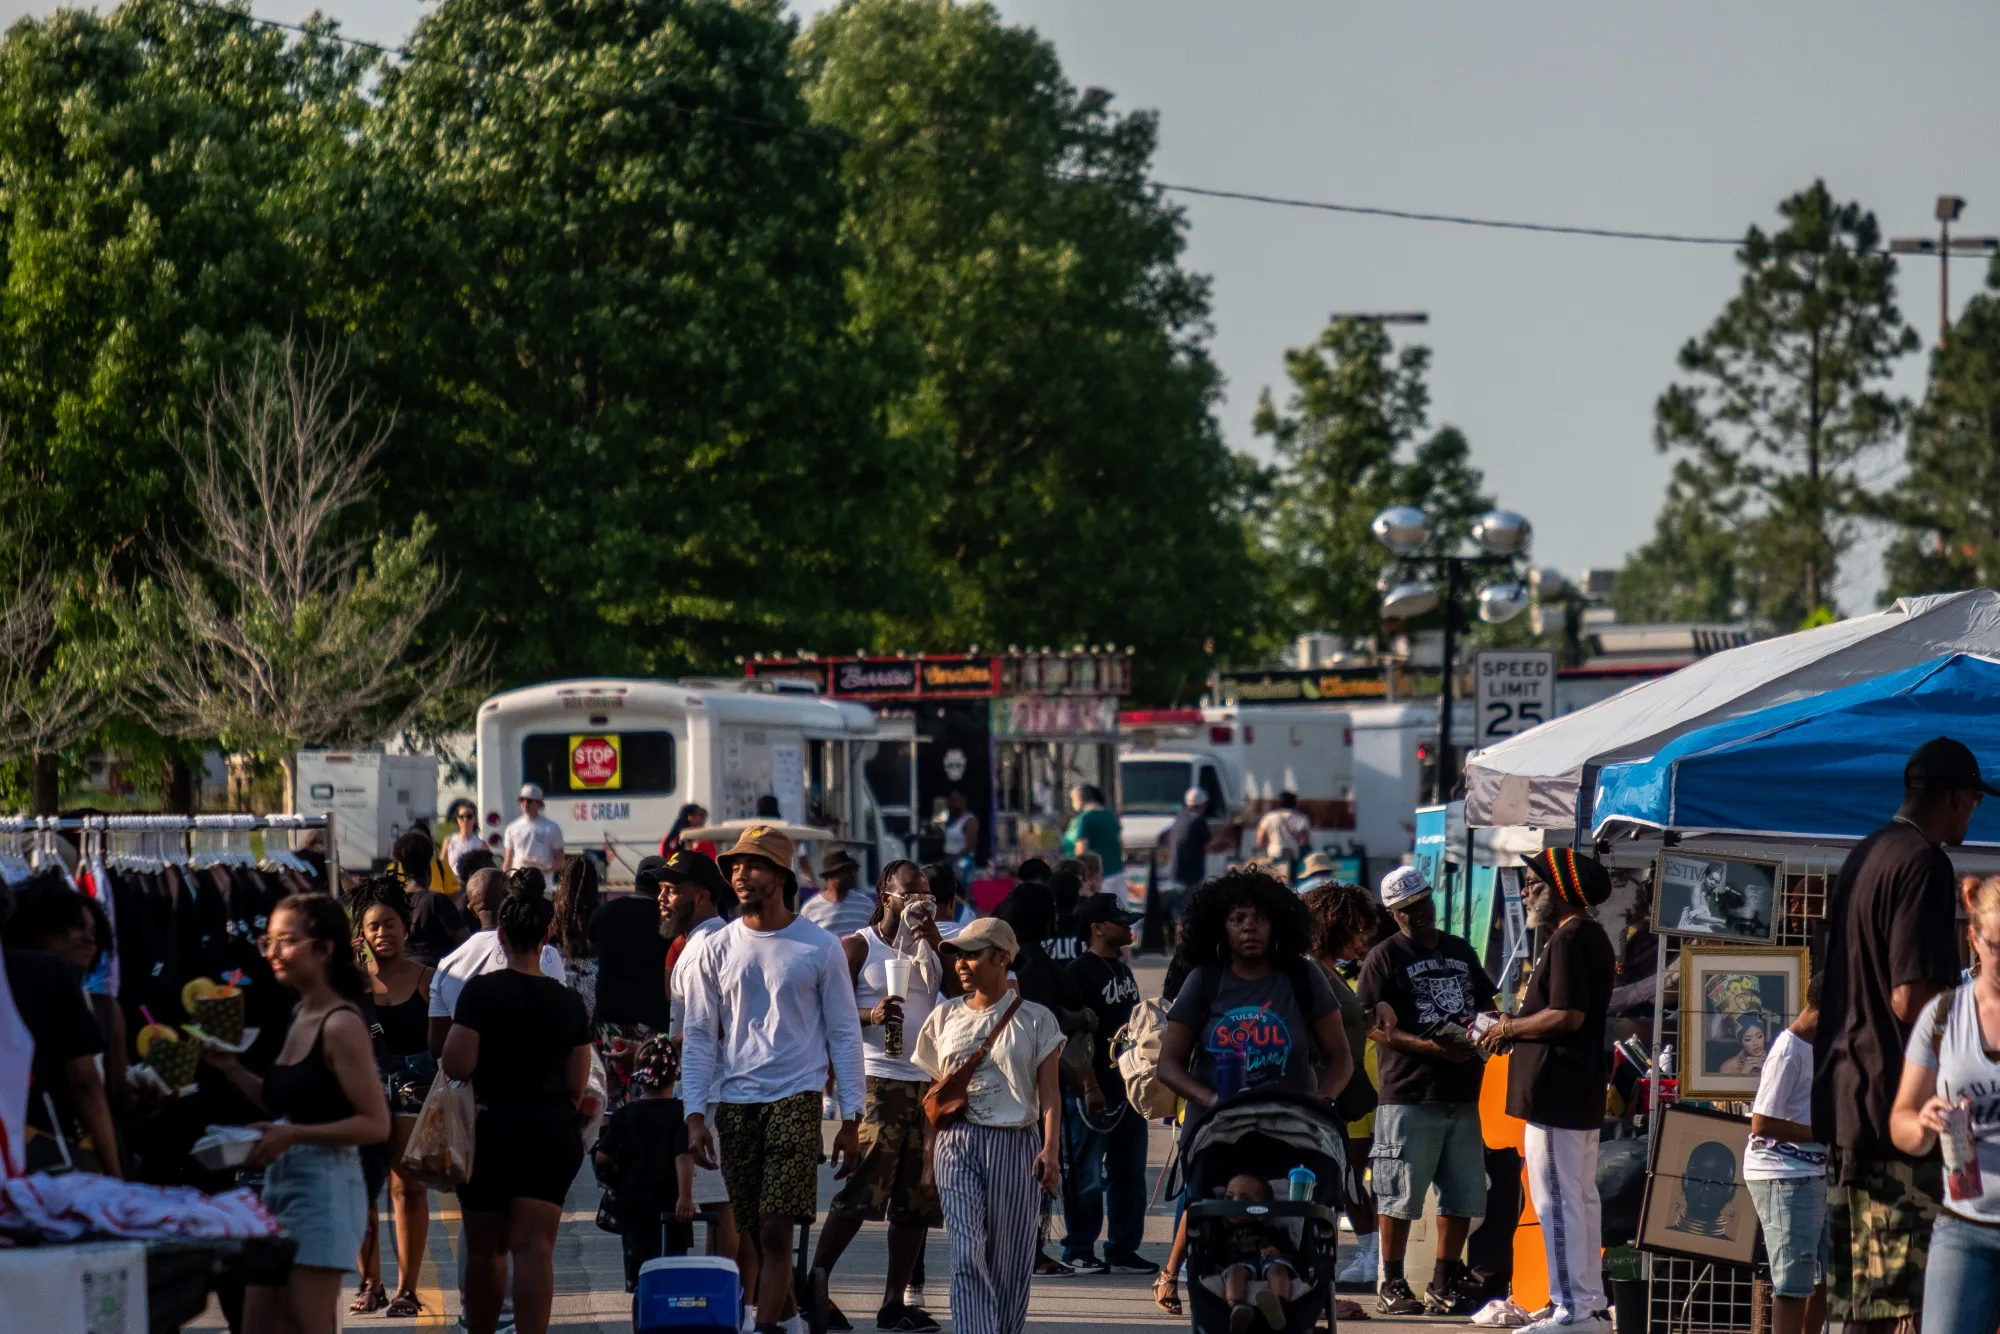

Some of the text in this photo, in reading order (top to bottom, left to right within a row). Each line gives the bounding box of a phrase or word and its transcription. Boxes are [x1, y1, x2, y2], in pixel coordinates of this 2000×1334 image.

[1482, 661, 1548, 677] SPEED
[1489, 682, 1540, 697] LIMIT
[1486, 702, 1543, 736] 25
[574, 746, 615, 765] STOP
[591, 802, 630, 821] CREAM
[1406, 960, 1428, 979] BLACK
[1101, 976, 1138, 1005] Unity
[1229, 1013, 1268, 1023] TULSA'S
[1216, 1024, 1286, 1050] SOUL
